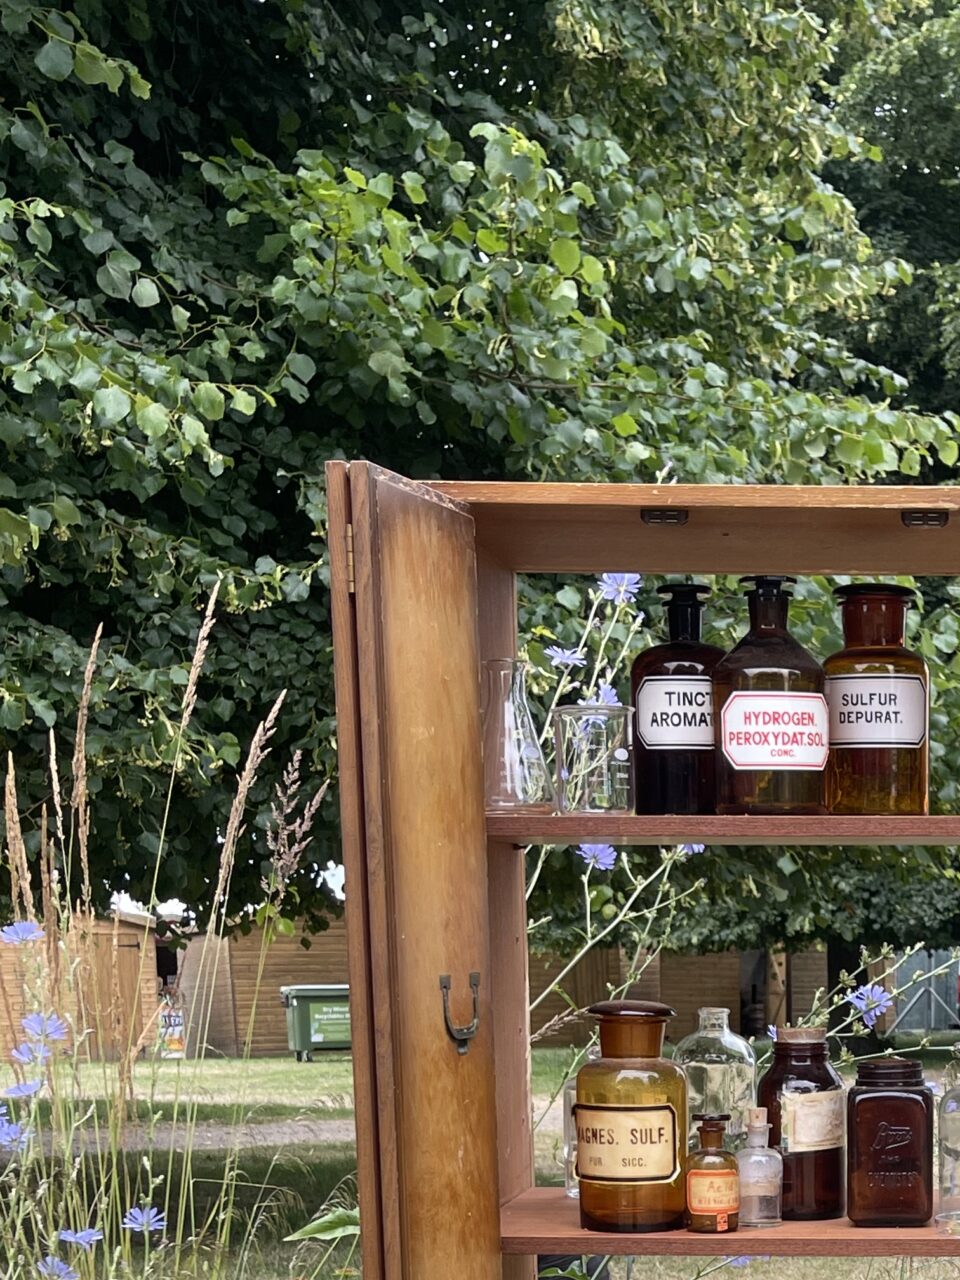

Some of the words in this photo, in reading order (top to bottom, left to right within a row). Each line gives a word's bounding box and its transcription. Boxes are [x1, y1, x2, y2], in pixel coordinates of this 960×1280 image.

[841, 693, 898, 706] SULFUR
[743, 711, 818, 726] HYDROGEN.
[839, 711, 903, 724] DEPURAT.
[770, 748, 797, 758] CONC.
[630, 1127, 669, 1145] SULF.
[621, 1157, 647, 1168] SICC.
